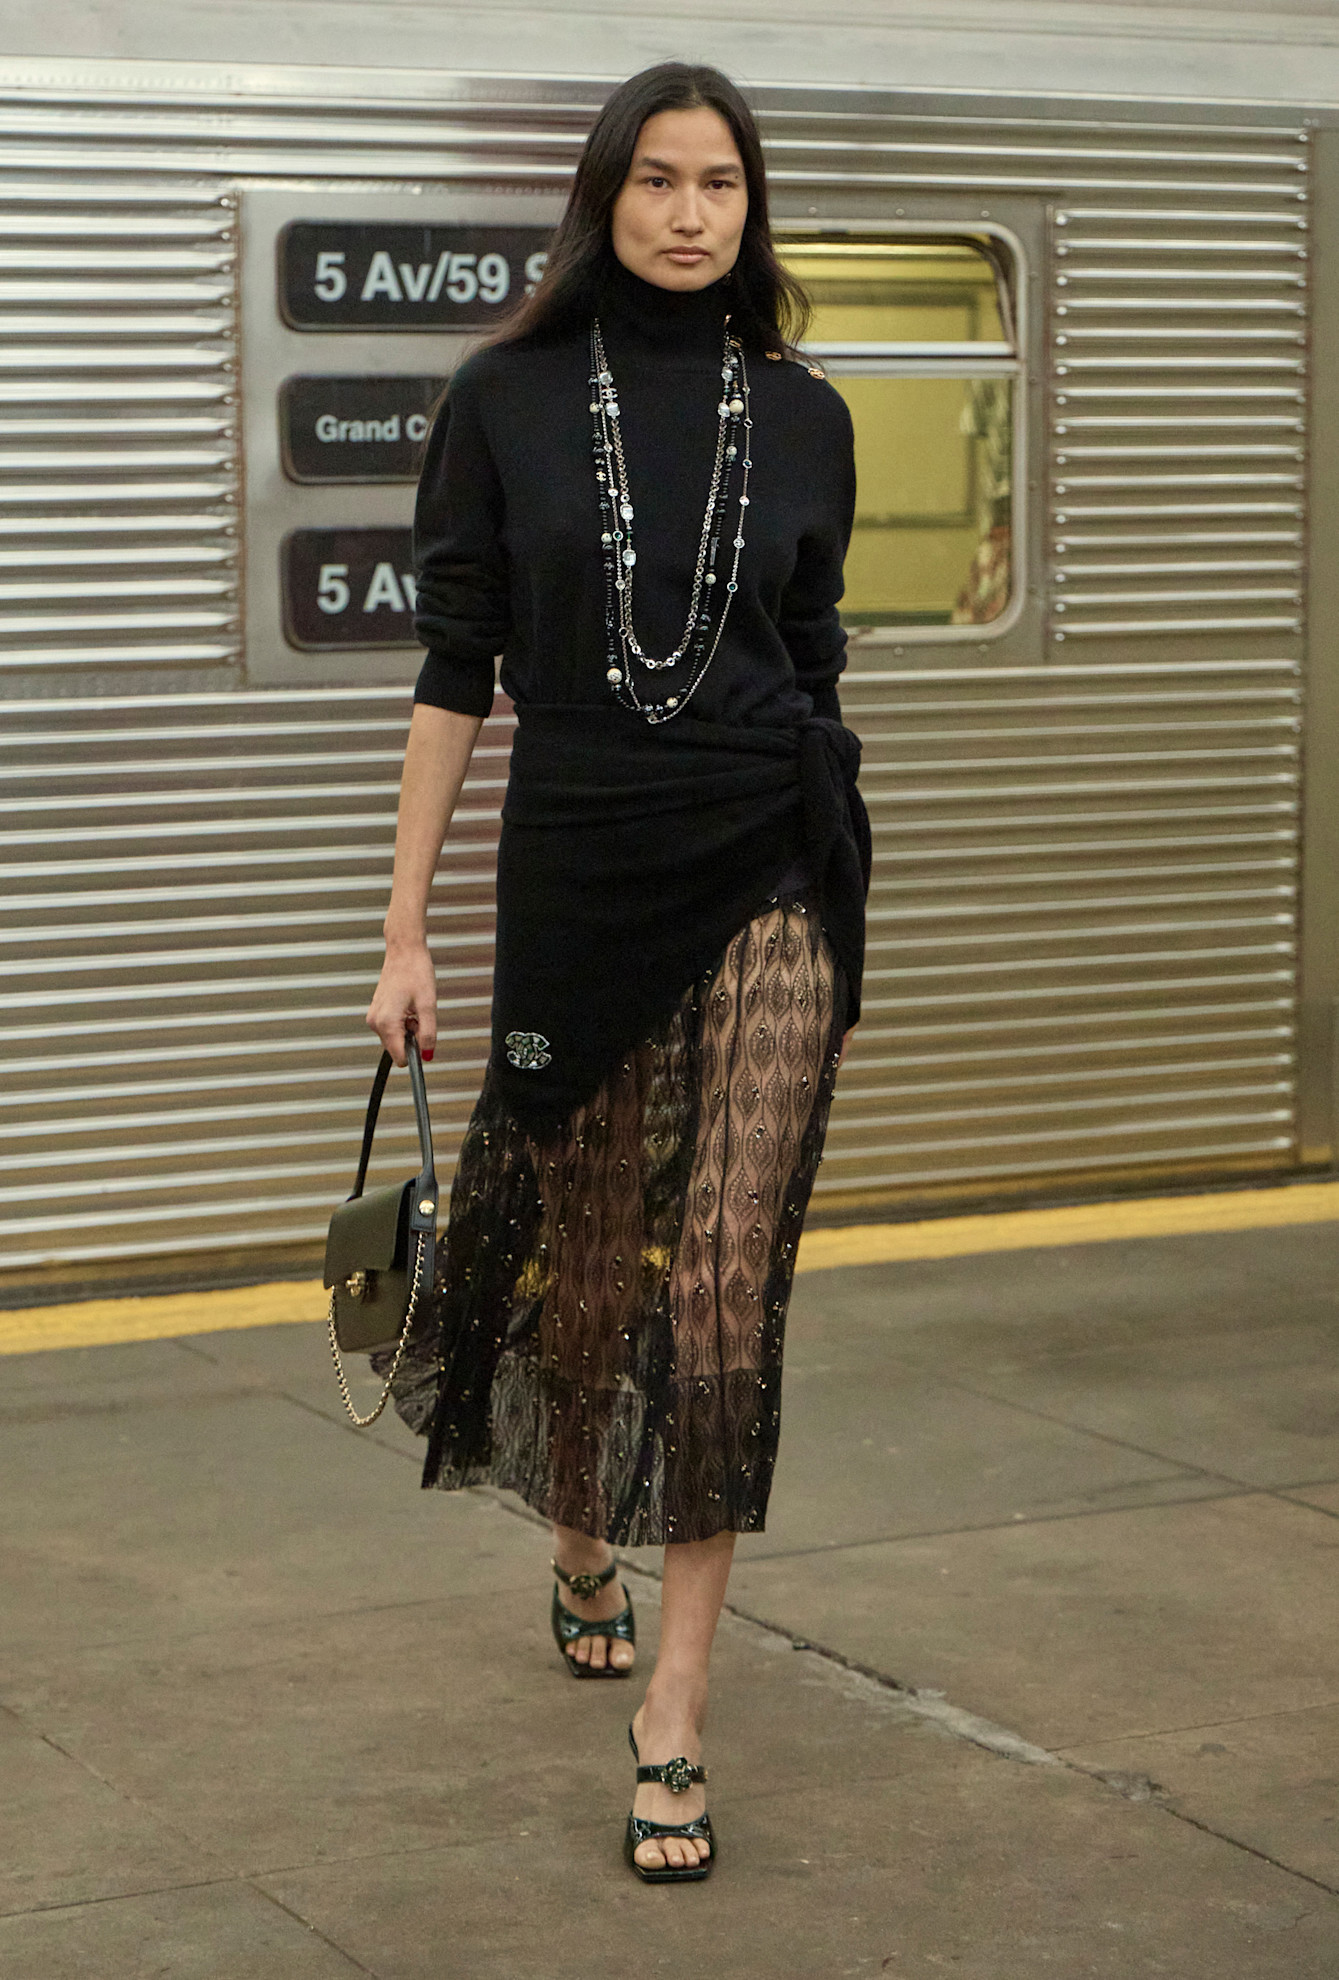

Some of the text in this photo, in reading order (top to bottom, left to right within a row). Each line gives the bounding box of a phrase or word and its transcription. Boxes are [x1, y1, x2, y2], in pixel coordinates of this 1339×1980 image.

[314, 250, 549, 303] 5 Av/59 S
[315, 414, 400, 442] Grand
[317, 563, 350, 614] 5
